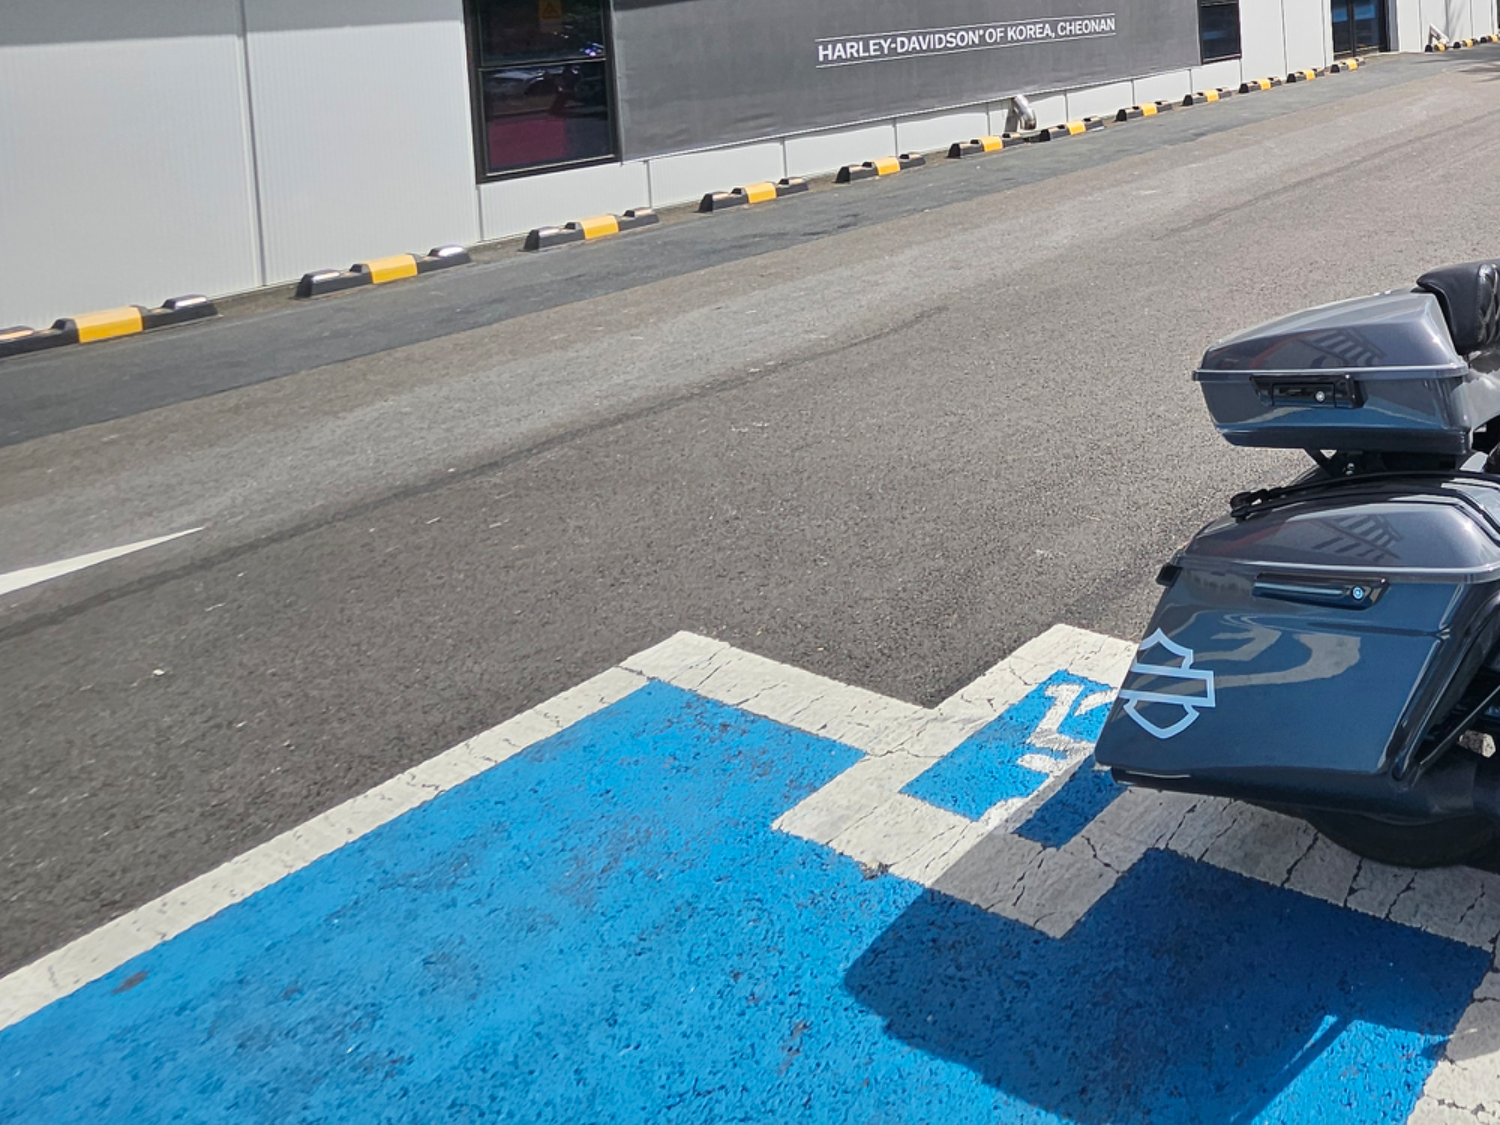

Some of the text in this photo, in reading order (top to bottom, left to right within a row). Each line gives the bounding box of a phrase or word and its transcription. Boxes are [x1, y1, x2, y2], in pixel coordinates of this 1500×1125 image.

[985, 28, 1005, 43] OF
[1007, 23, 1055, 40] KOREA,
[1057, 18, 1115, 35] CHEONAN
